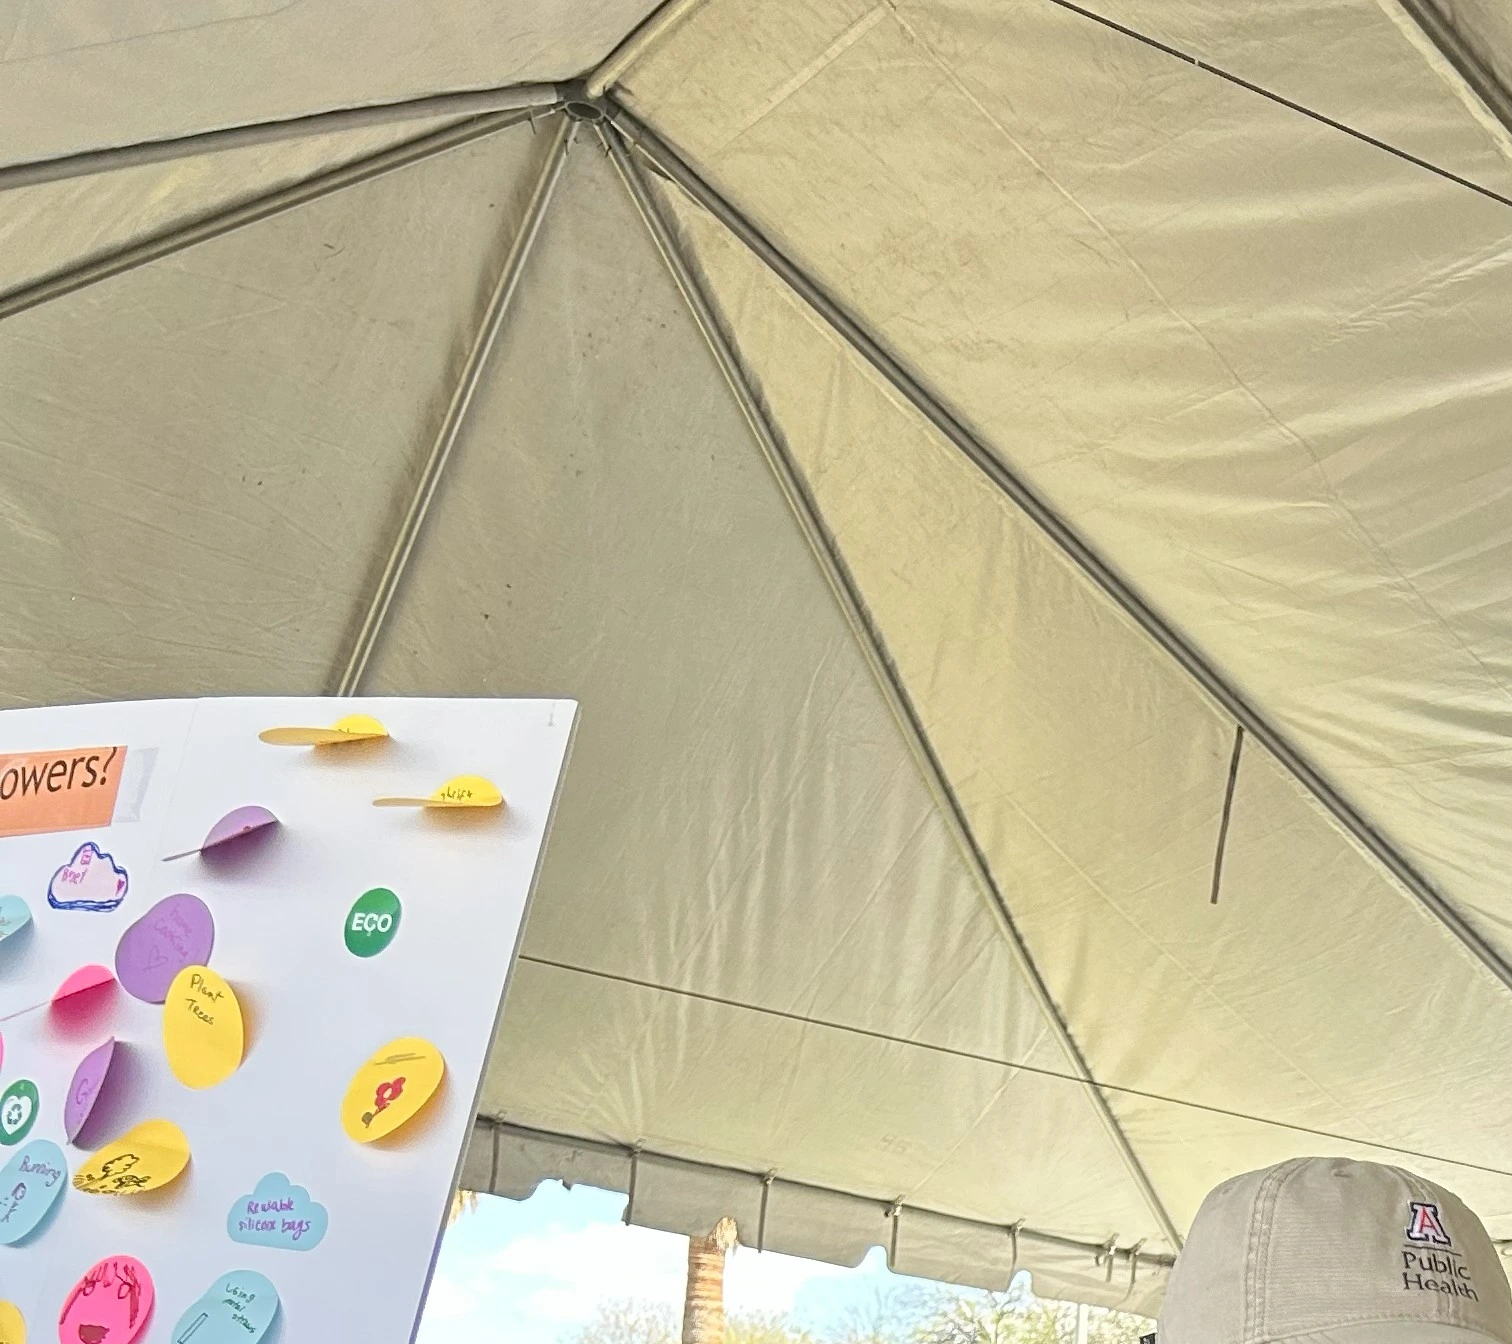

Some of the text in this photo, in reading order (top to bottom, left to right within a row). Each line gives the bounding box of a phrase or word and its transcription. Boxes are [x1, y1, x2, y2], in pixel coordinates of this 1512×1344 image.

[352, 912, 392, 932] ECO
[191, 974, 224, 1002] Plant
[185, 998, 214, 1025] Trees
[281, 1218, 311, 1240] bags
[1406, 1202, 1451, 1245] A
[1401, 1251, 1471, 1280] Public
[1402, 1272, 1479, 1302] Health
